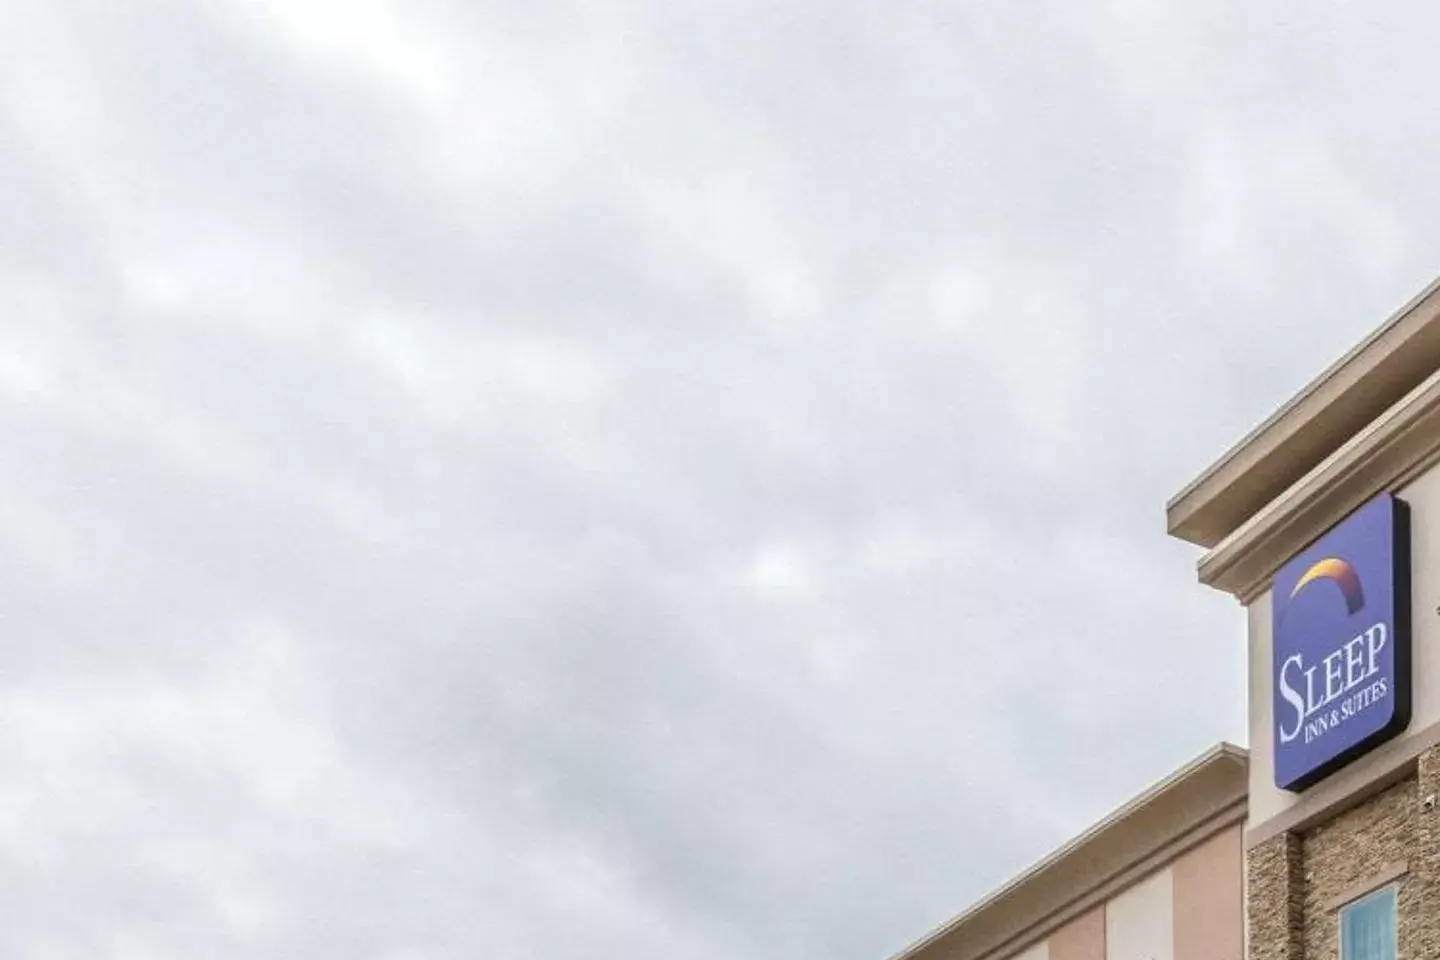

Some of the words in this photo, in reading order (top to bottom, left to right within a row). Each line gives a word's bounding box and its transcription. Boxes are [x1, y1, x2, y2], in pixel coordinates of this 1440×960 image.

[1280, 622, 1387, 744] SLEEP
[1305, 714, 1329, 744] INN
[1329, 709, 1340, 728] &
[1341, 677, 1388, 720] SUITES
